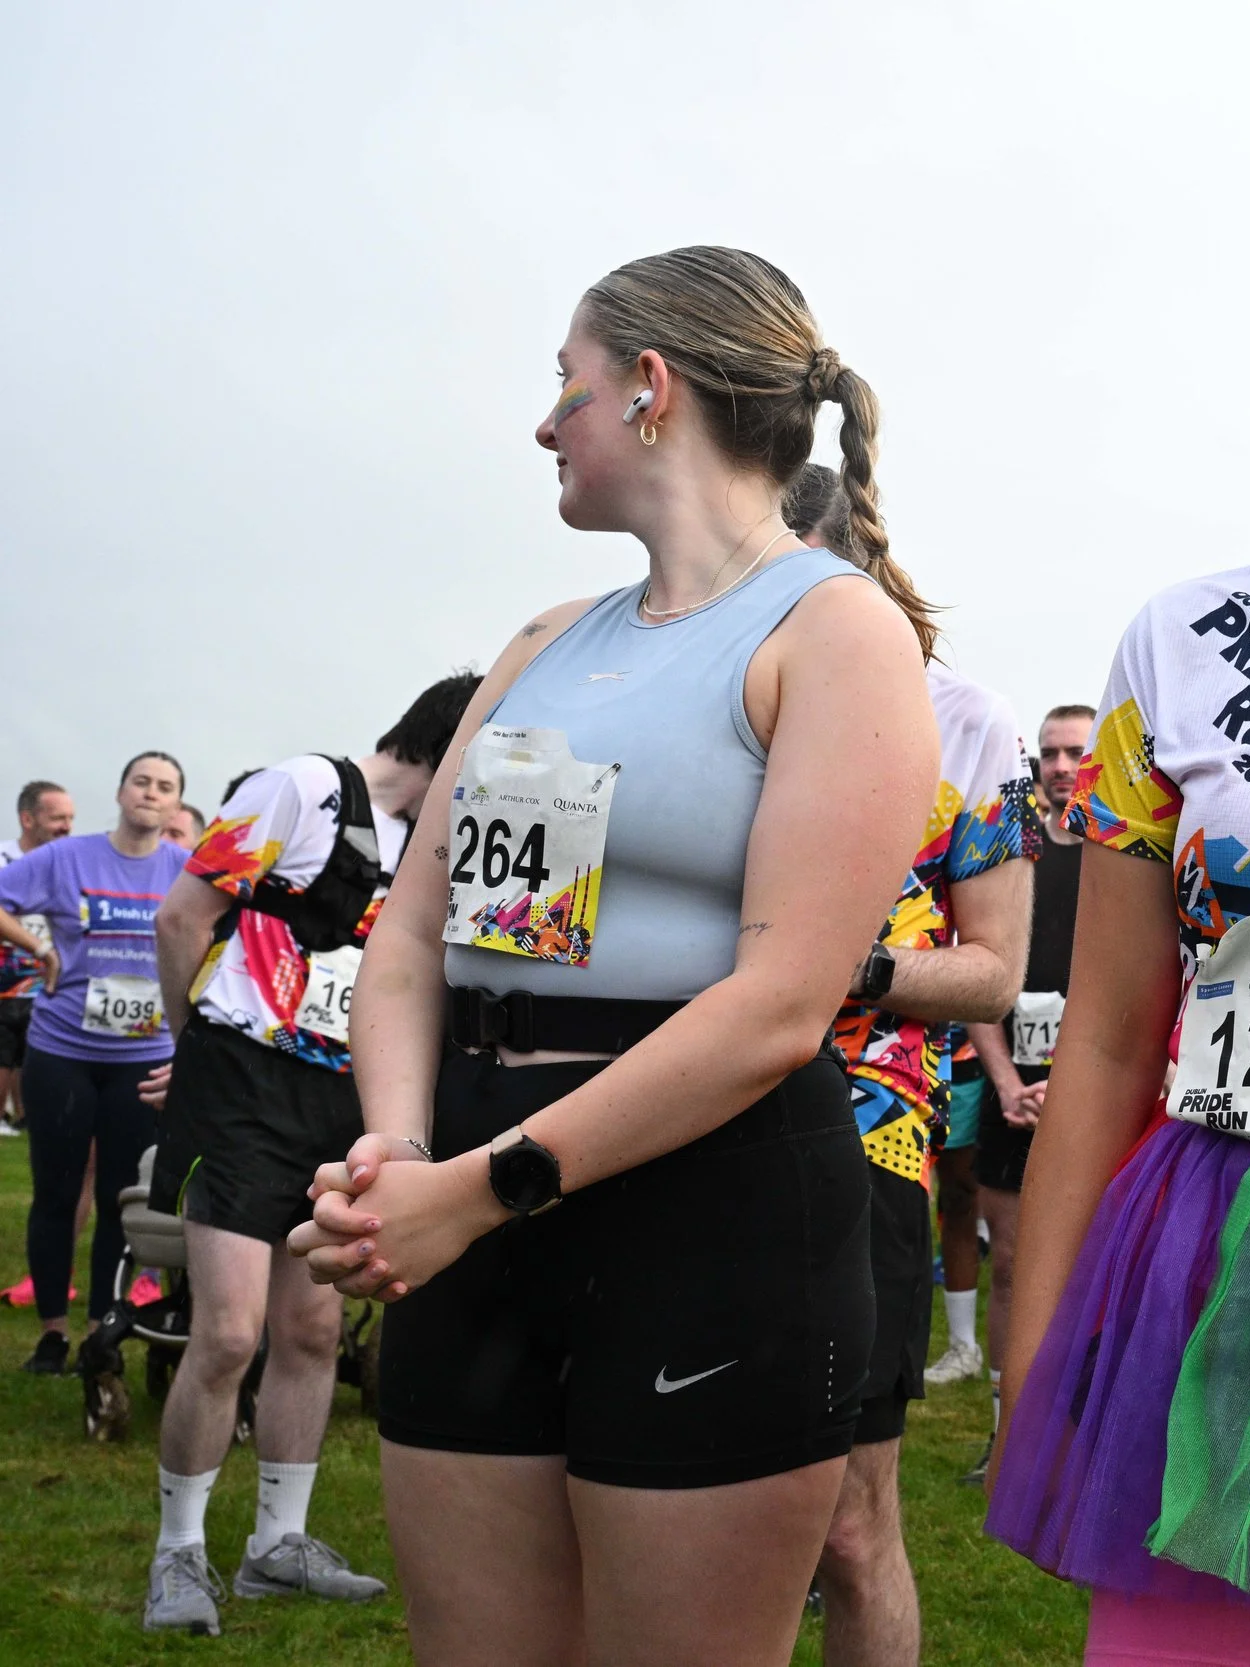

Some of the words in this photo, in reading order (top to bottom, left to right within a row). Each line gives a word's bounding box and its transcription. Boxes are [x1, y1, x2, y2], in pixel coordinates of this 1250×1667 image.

[498, 794, 524, 804] ARTHUR
[525, 797, 541, 806] COX
[553, 798, 598, 813] QUANTA
[451, 815, 550, 893] 264
[100, 997, 154, 1020] 1039
[1017, 1021, 1061, 1045] 171
[1178, 1093, 1233, 1112] PRIDE
[1206, 1111, 1248, 1130] RUN
